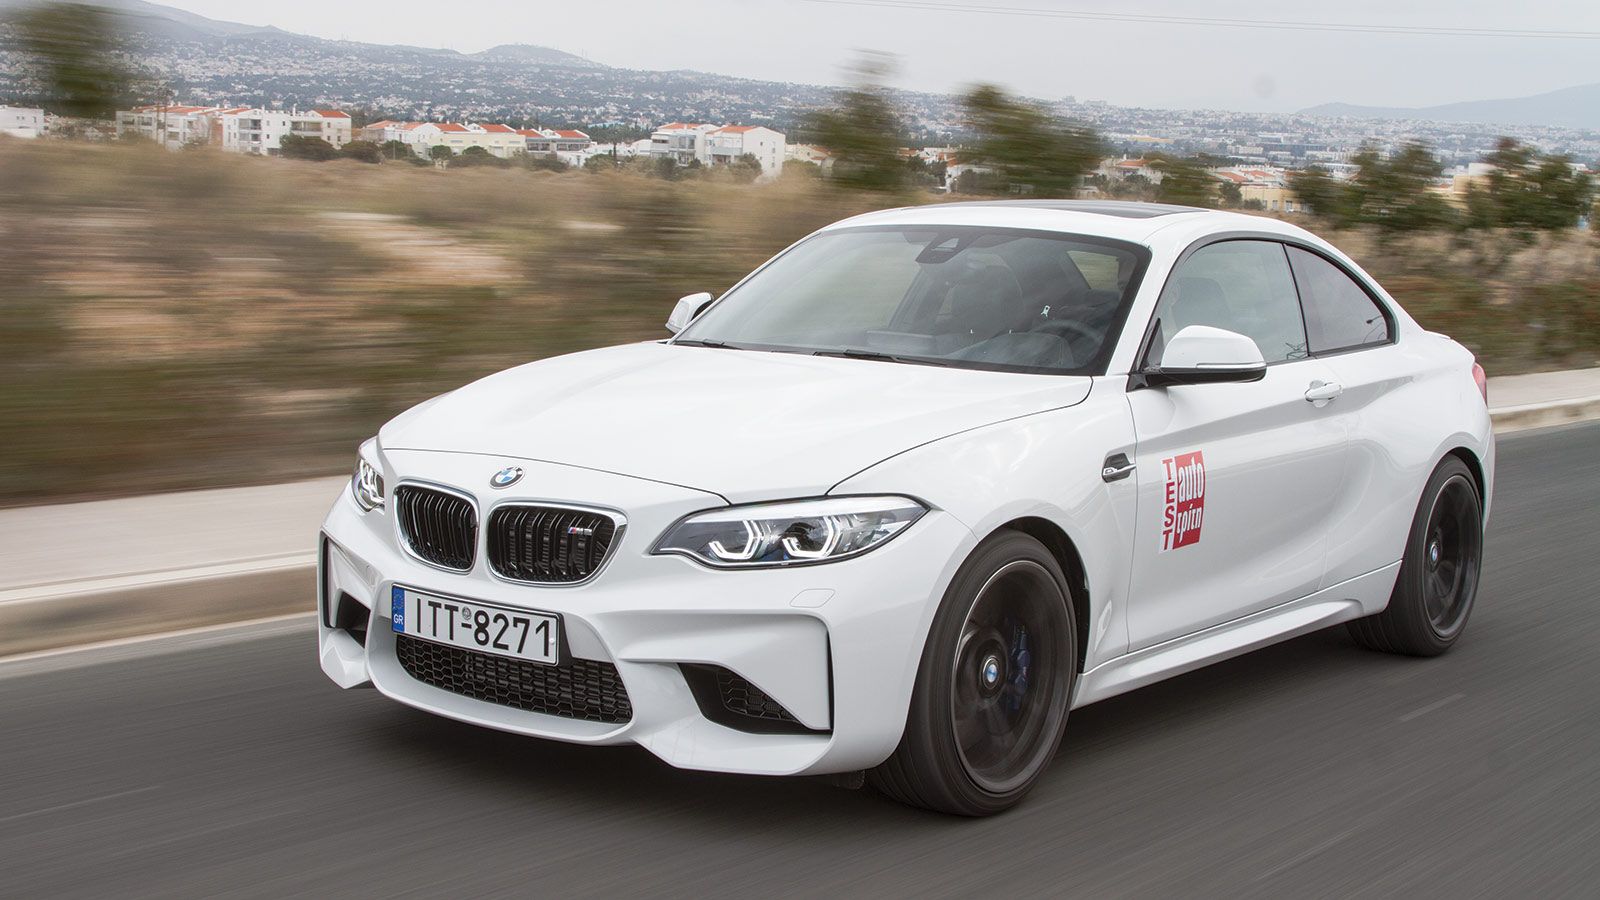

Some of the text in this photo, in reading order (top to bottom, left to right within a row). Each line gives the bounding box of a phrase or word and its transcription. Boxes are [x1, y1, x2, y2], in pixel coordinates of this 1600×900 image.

[1162, 458, 1175, 550] TEST
[1178, 455, 1204, 503] auto
[393, 614, 404, 625] GR
[416, 598, 550, 657] ITT-8271
